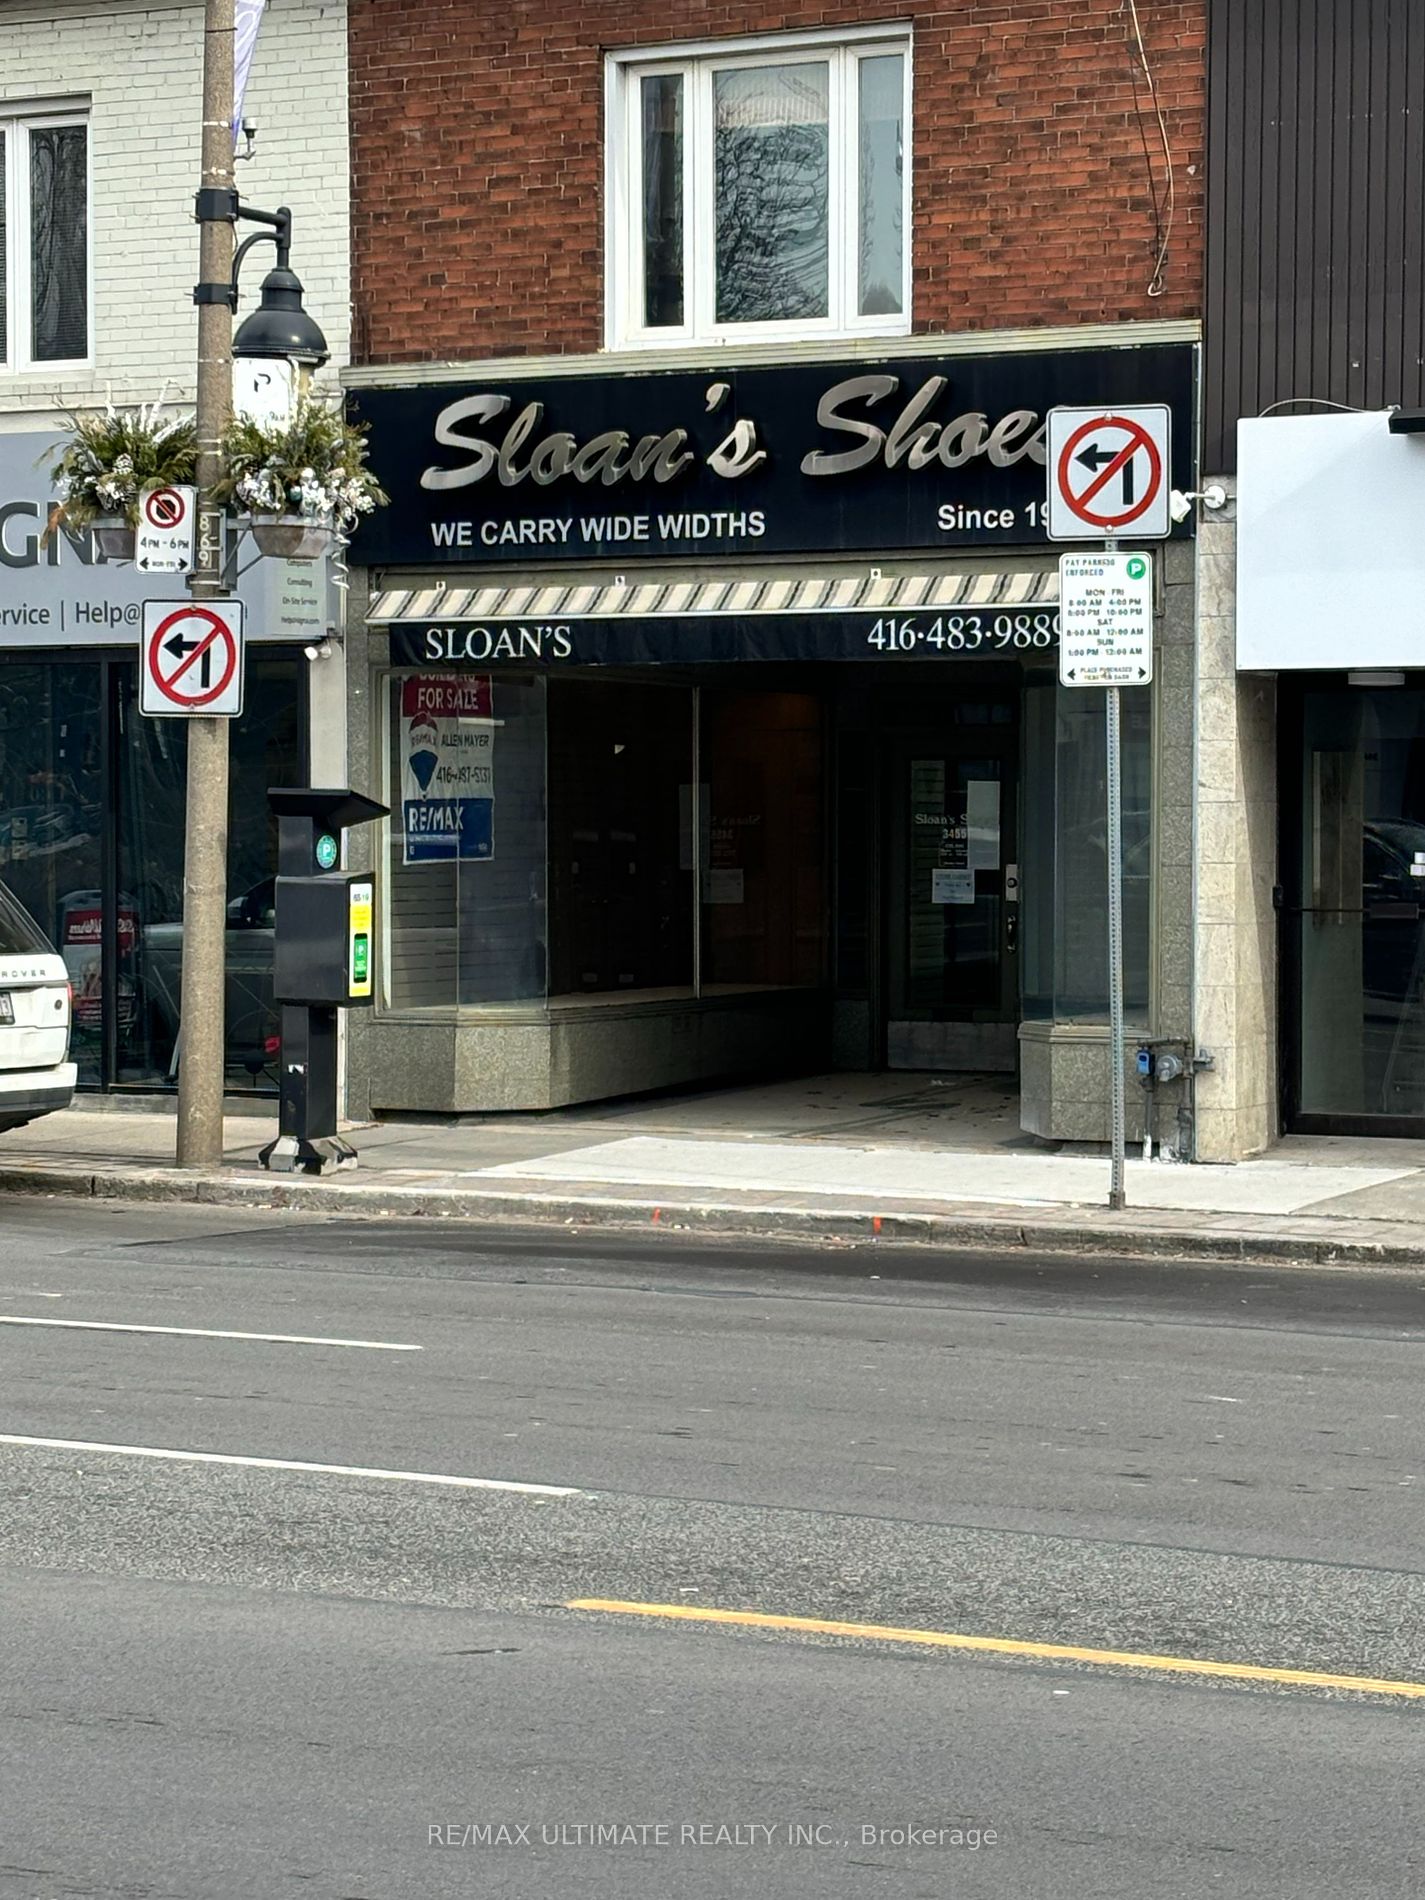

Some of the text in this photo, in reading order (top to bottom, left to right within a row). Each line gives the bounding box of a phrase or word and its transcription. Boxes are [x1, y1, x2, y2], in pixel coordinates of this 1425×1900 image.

[420, 383, 767, 491] Sloan's
[431, 510, 766, 547] WE CARRY WIDE WIDTHS
[938, 504, 1014, 530] Since
[0, 602, 50, 625] rvice
[426, 624, 572, 660] SLOAN'S
[418, 688, 479, 710] FOR SALE
[441, 735, 463, 747] ALLEN
[464, 734, 489, 747] MAYER
[409, 806, 464, 832] RE/MAX
[2, 970, 46, 978] ROVER
